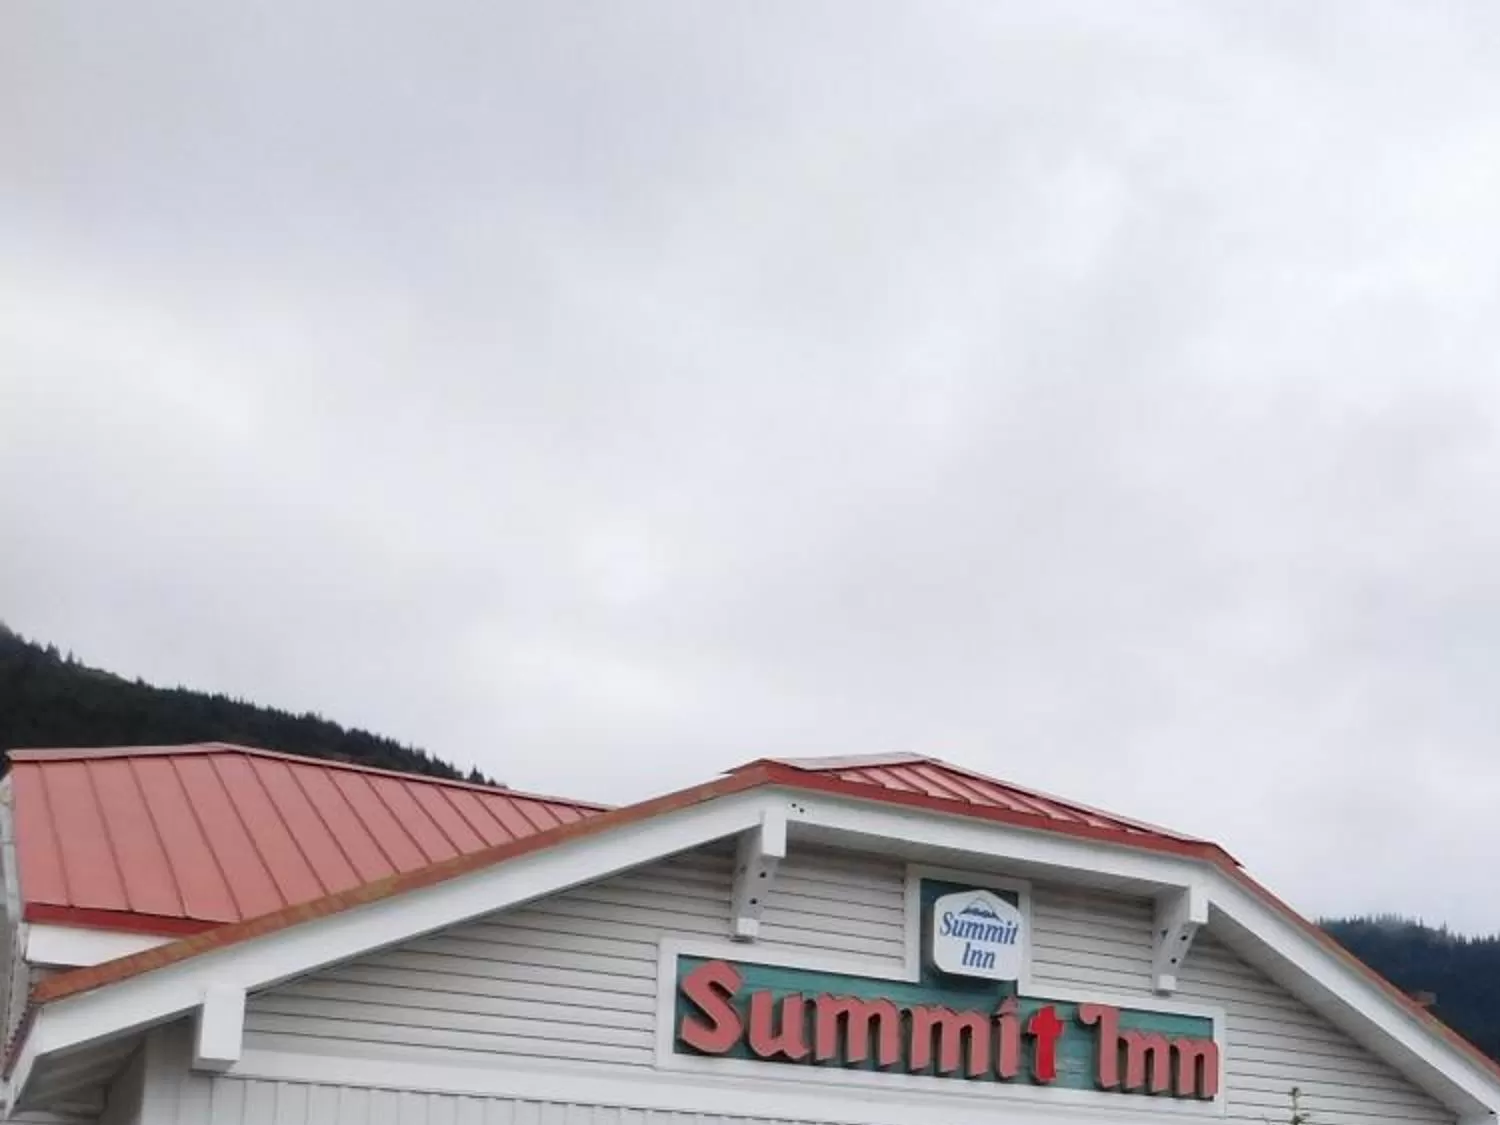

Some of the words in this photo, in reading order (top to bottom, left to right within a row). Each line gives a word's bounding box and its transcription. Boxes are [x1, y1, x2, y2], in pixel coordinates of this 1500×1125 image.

[940, 911, 1019, 945] Summit
[961, 941, 996, 969] Inn
[680, 959, 1063, 1083] Summit
[1078, 1002, 1219, 1099] Inn
